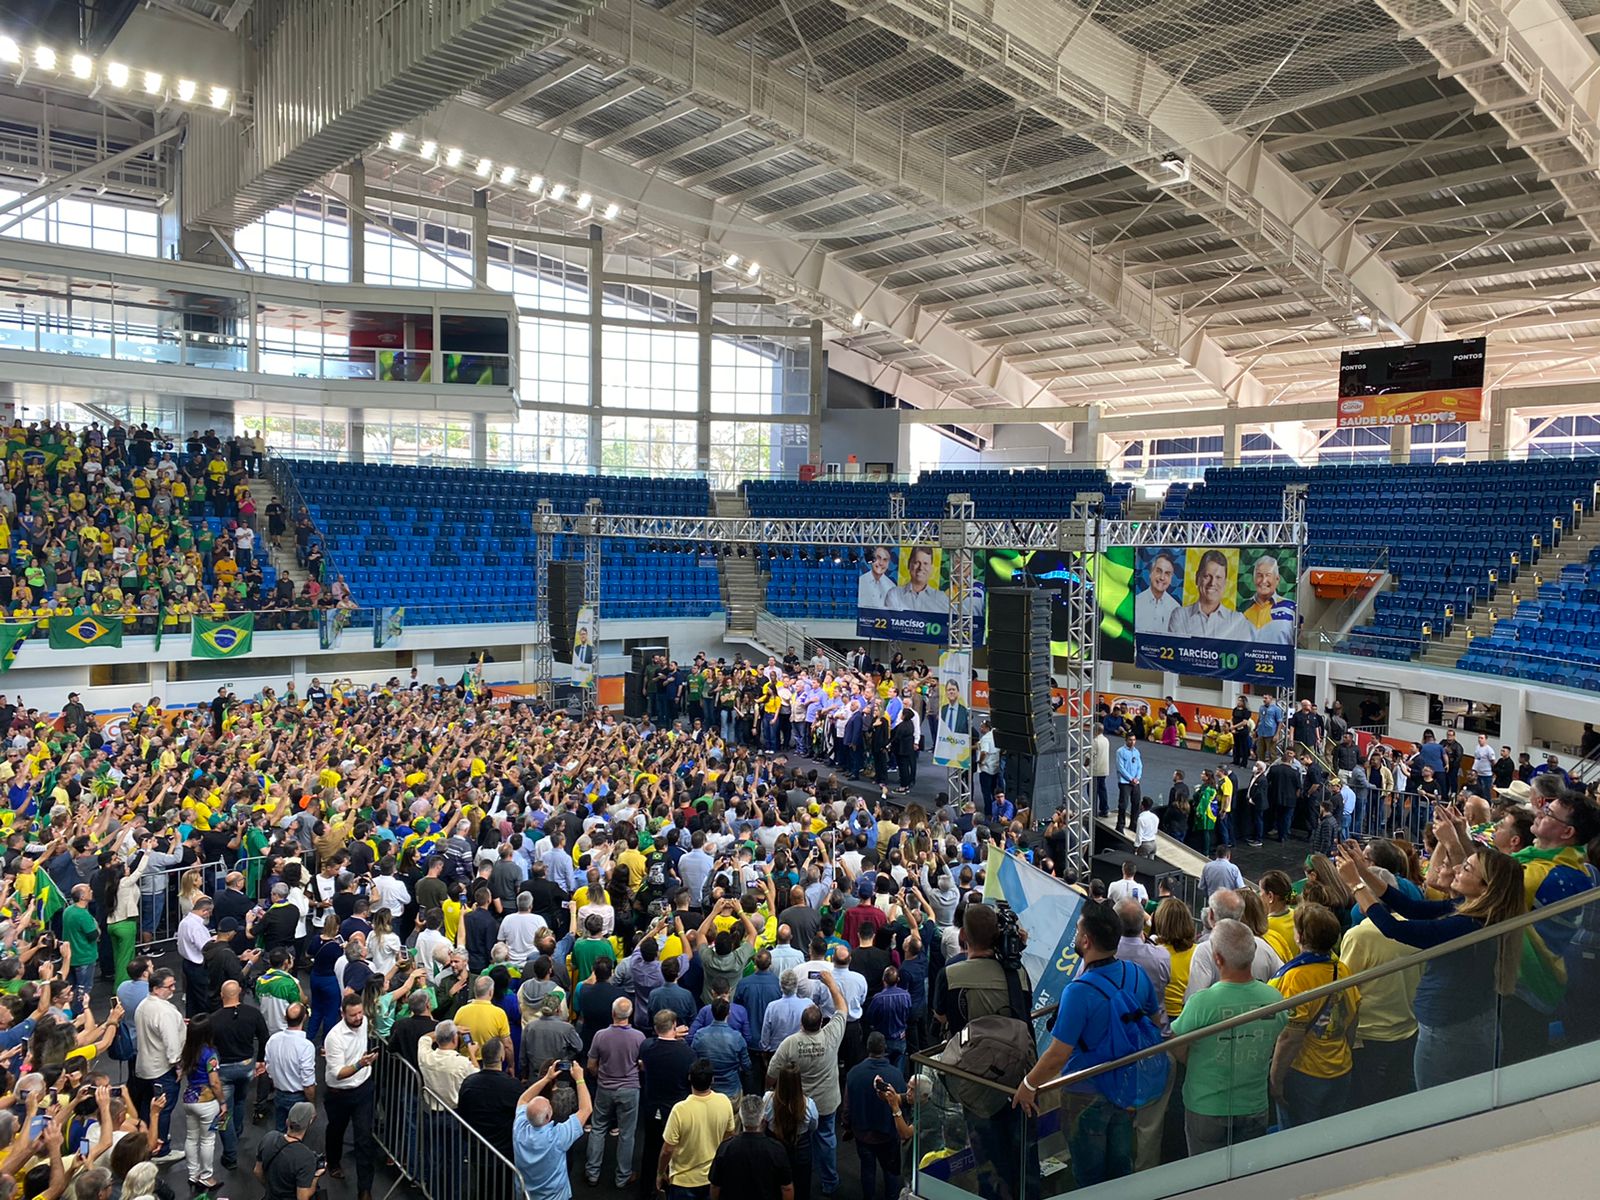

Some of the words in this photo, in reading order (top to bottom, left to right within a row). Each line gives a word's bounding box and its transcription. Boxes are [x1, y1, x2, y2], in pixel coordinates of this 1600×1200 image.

[1340, 415, 1377, 426] SAÚDE
[1380, 415, 1411, 424] PARA
[875, 618, 887, 629] 22
[890, 618, 925, 628] TARCÍSIO
[925, 622, 941, 635] 10
[1160, 646, 1174, 660] 22
[1178, 647, 1219, 660] TARCÍSIO
[1219, 652, 1239, 669] 10
[1244, 652, 1265, 660] MARCOS
[1255, 663, 1274, 673] 222
